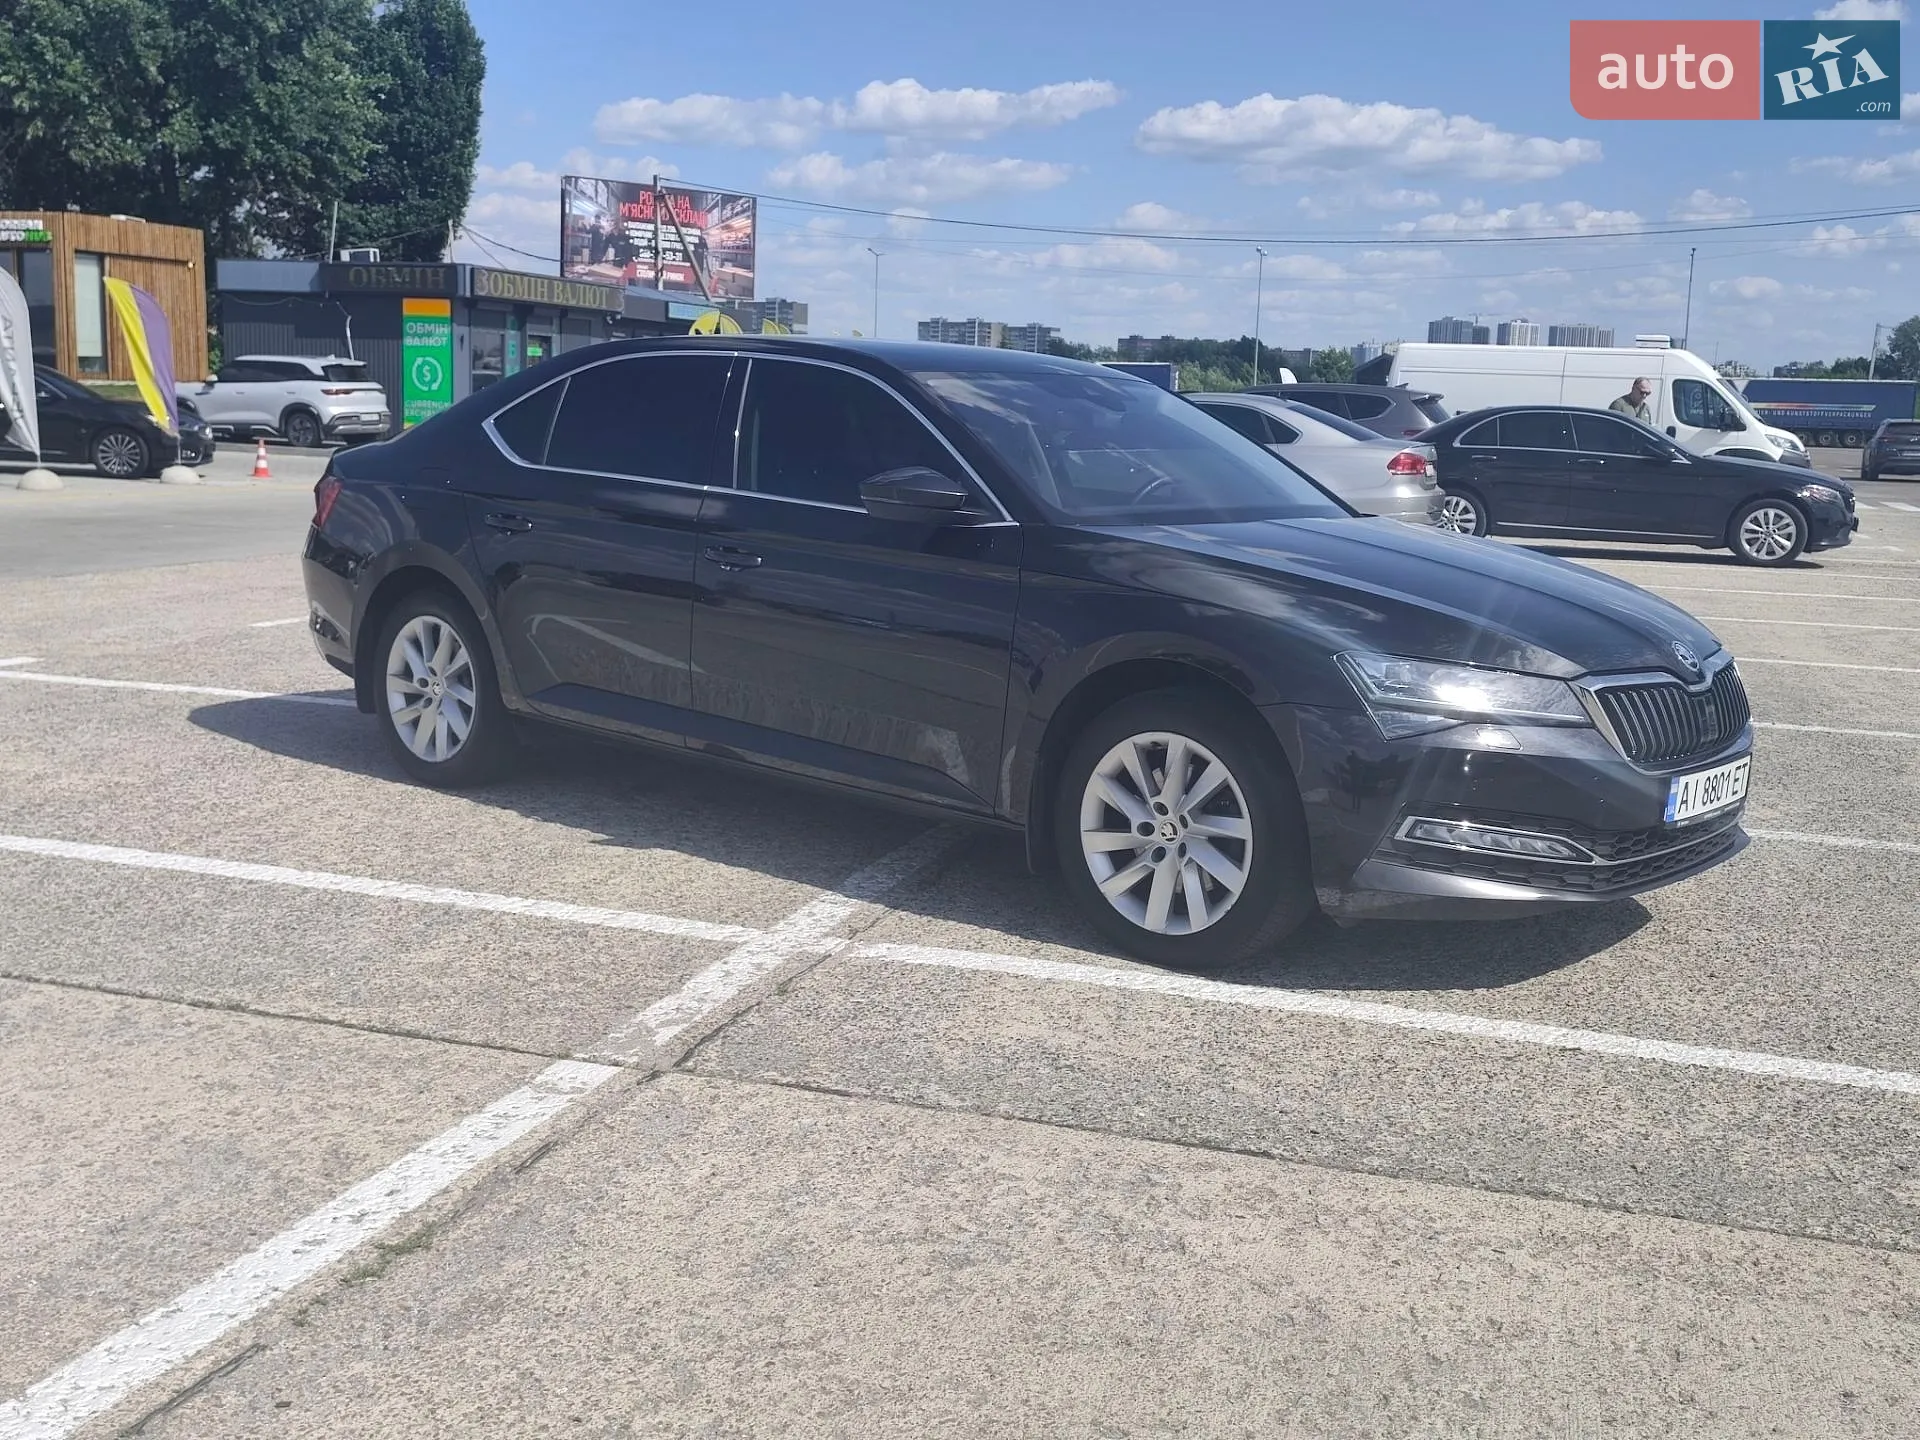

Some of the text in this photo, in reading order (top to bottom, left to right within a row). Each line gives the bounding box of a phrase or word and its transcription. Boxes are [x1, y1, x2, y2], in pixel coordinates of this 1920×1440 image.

[349, 266, 446, 289] ОБМІН
[554, 278, 609, 310] ВАЛЮТ
[406, 322, 450, 334] ОБМІН
[405, 336, 448, 347] ВАЛЮТ
[1677, 779, 1699, 814] AI
[1702, 768, 1731, 806] 8801
[1731, 762, 1748, 796] ET
